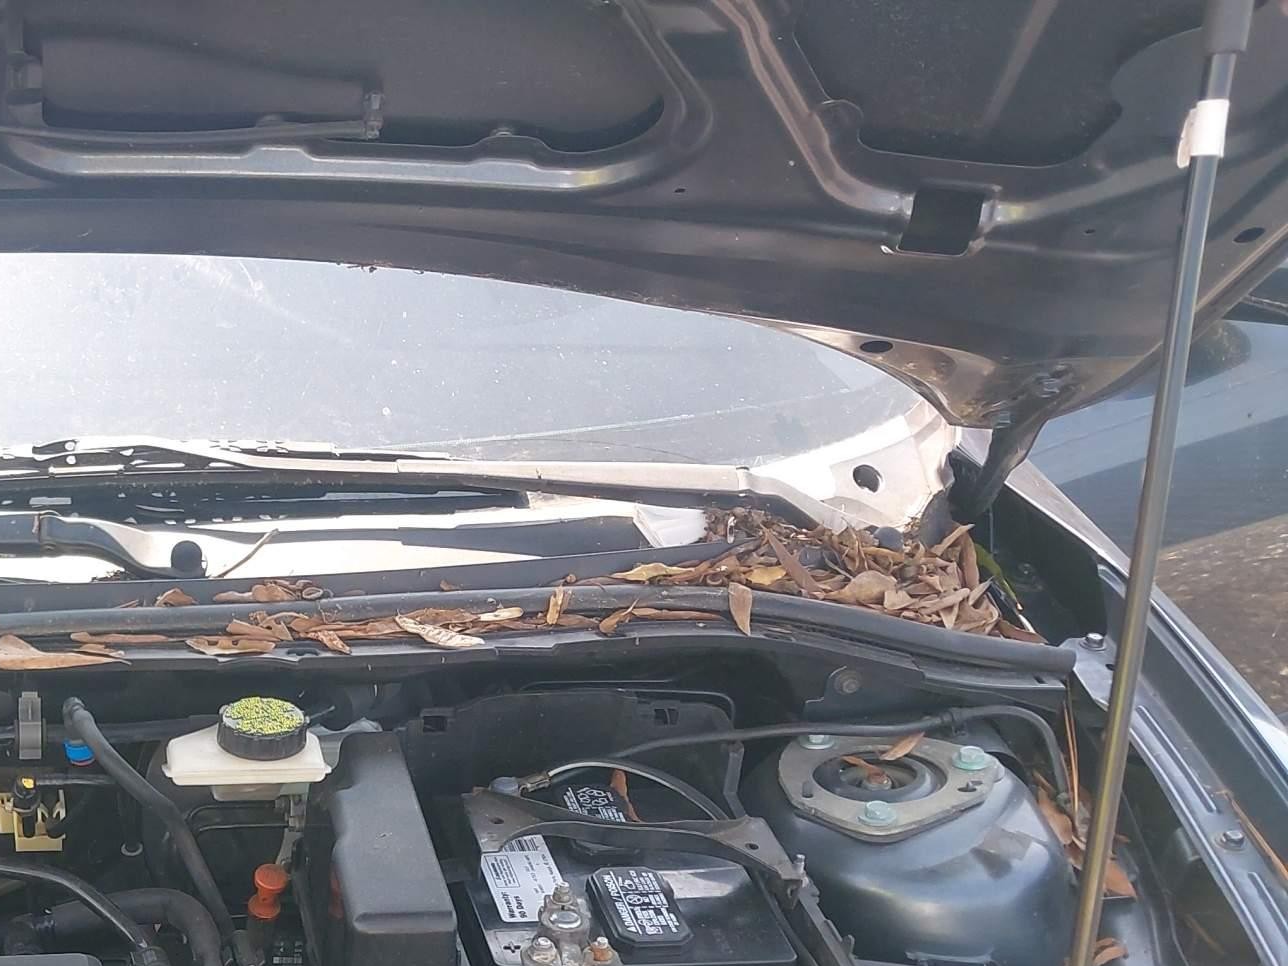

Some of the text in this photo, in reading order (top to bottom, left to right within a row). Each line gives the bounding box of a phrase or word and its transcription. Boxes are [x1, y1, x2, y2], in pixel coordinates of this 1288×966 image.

[602, 874, 620, 897] POISON
[501, 891, 517, 918] Warranty:
[514, 895, 527, 919] 90 Days
[615, 901, 634, 926] DANGER
